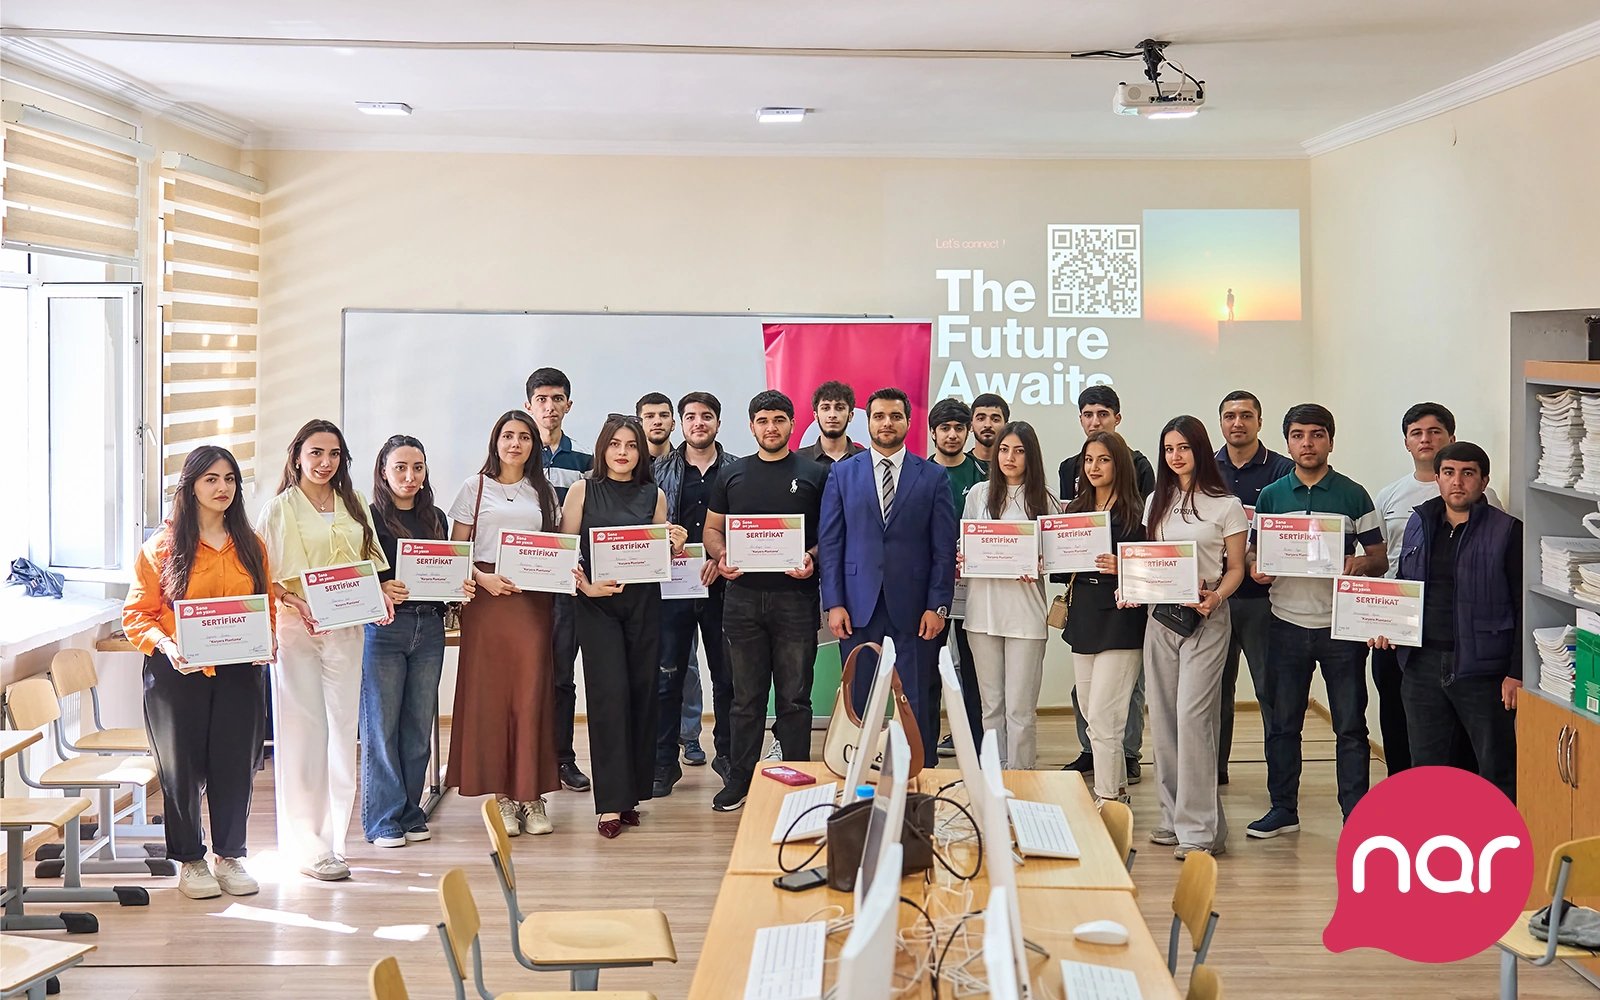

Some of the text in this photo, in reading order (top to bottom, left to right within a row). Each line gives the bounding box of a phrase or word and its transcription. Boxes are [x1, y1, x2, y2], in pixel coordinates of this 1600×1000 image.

[935, 238, 960, 249] Let's
[962, 240, 999, 249] connect
[936, 269, 1036, 313] The
[938, 315, 1109, 360] Future
[1058, 530, 1092, 538] SERTİFİKAT
[612, 542, 650, 550] SERTİFİKAT
[519, 549, 558, 557] SERTİFİKAT
[325, 581, 360, 592] SERTİFİKAT
[1356, 597, 1399, 605] SERTİFİKAT
[202, 616, 246, 626] SERTİFİKAT
